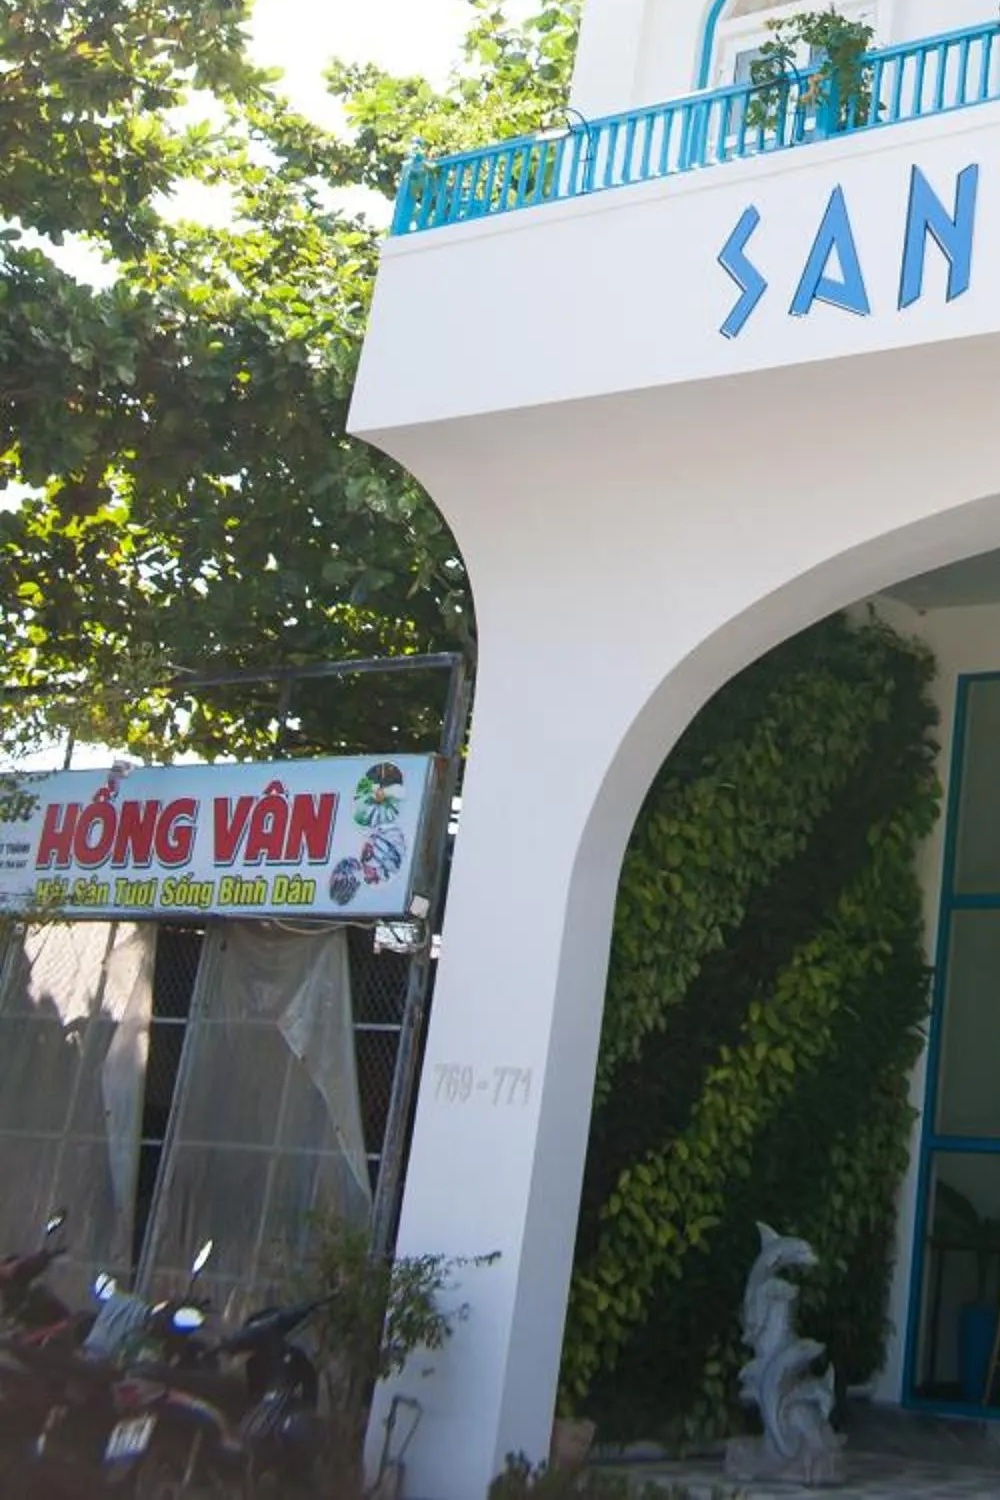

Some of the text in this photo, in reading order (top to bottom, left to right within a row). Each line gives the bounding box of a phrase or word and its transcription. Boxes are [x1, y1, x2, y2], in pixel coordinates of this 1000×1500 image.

[213, 779, 340, 868] VÂN
[160, 871, 215, 909] Sống
[271, 873, 317, 905] Dân
